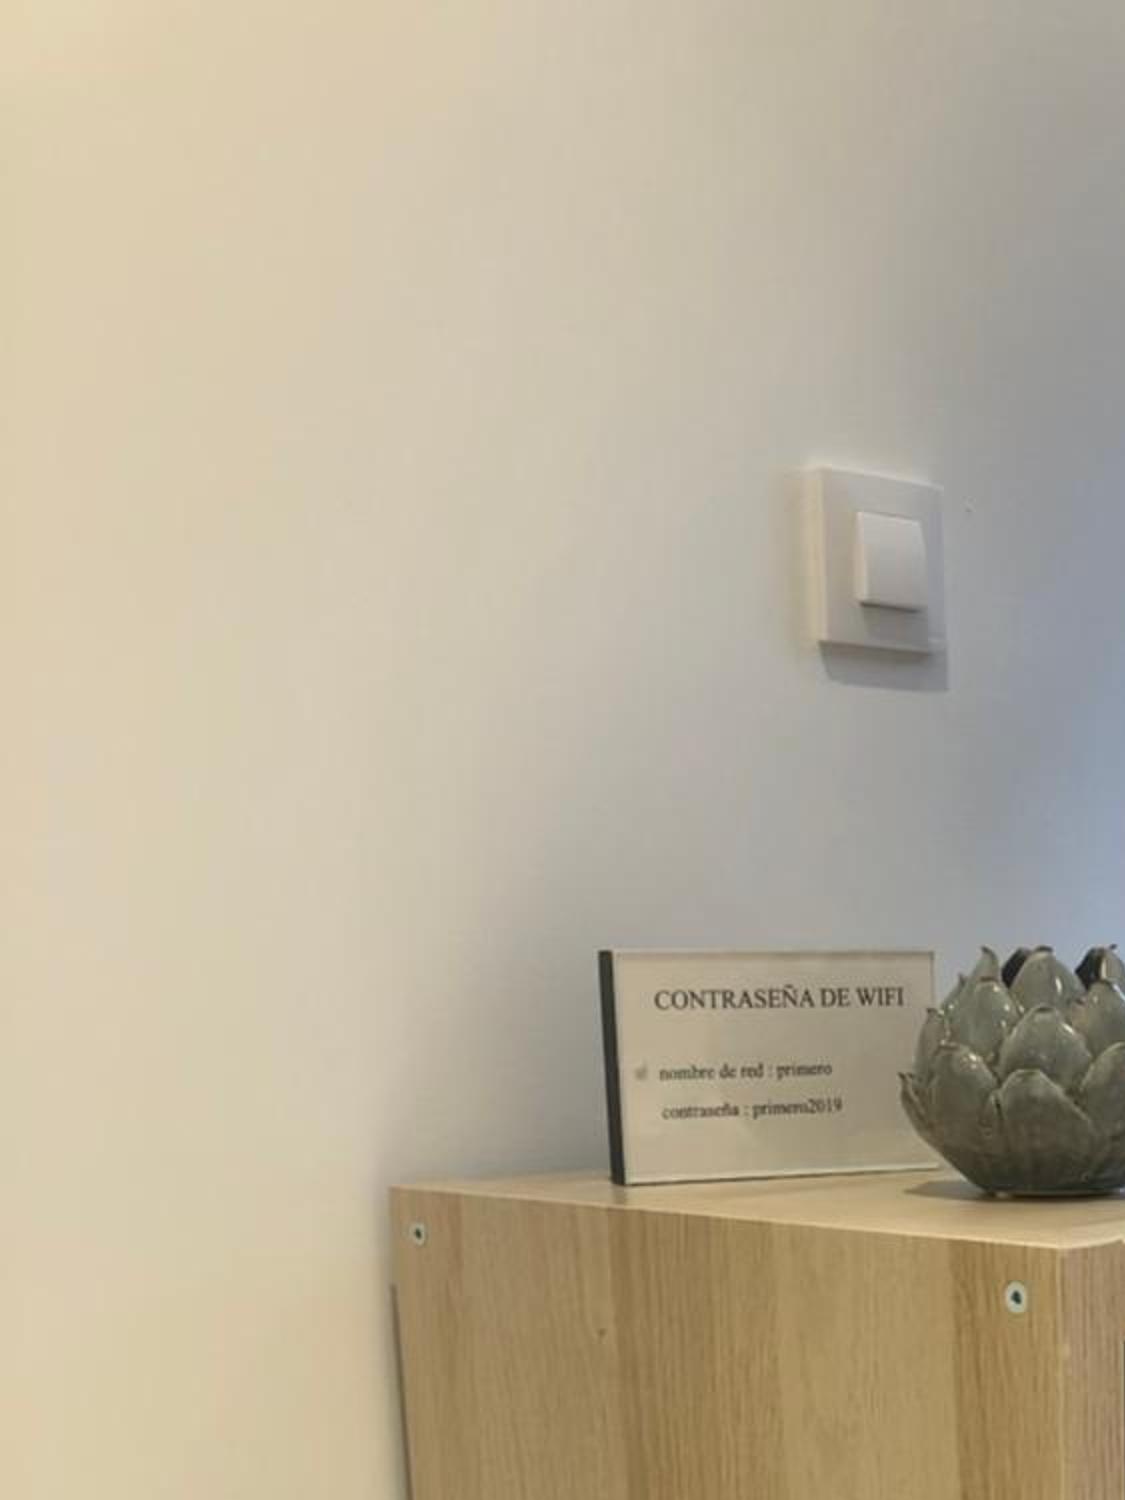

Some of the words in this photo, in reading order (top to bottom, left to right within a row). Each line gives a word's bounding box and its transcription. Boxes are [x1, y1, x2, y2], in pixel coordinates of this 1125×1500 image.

[654, 984, 815, 1011] CONTRASEÑA
[820, 988, 850, 1008] DE
[856, 986, 904, 1007] WIFI
[659, 1064, 715, 1081] nombre
[719, 1063, 737, 1079] de
[741, 1062, 764, 1078] red
[776, 1064, 833, 1081] primero
[661, 1102, 739, 1120] contraseña
